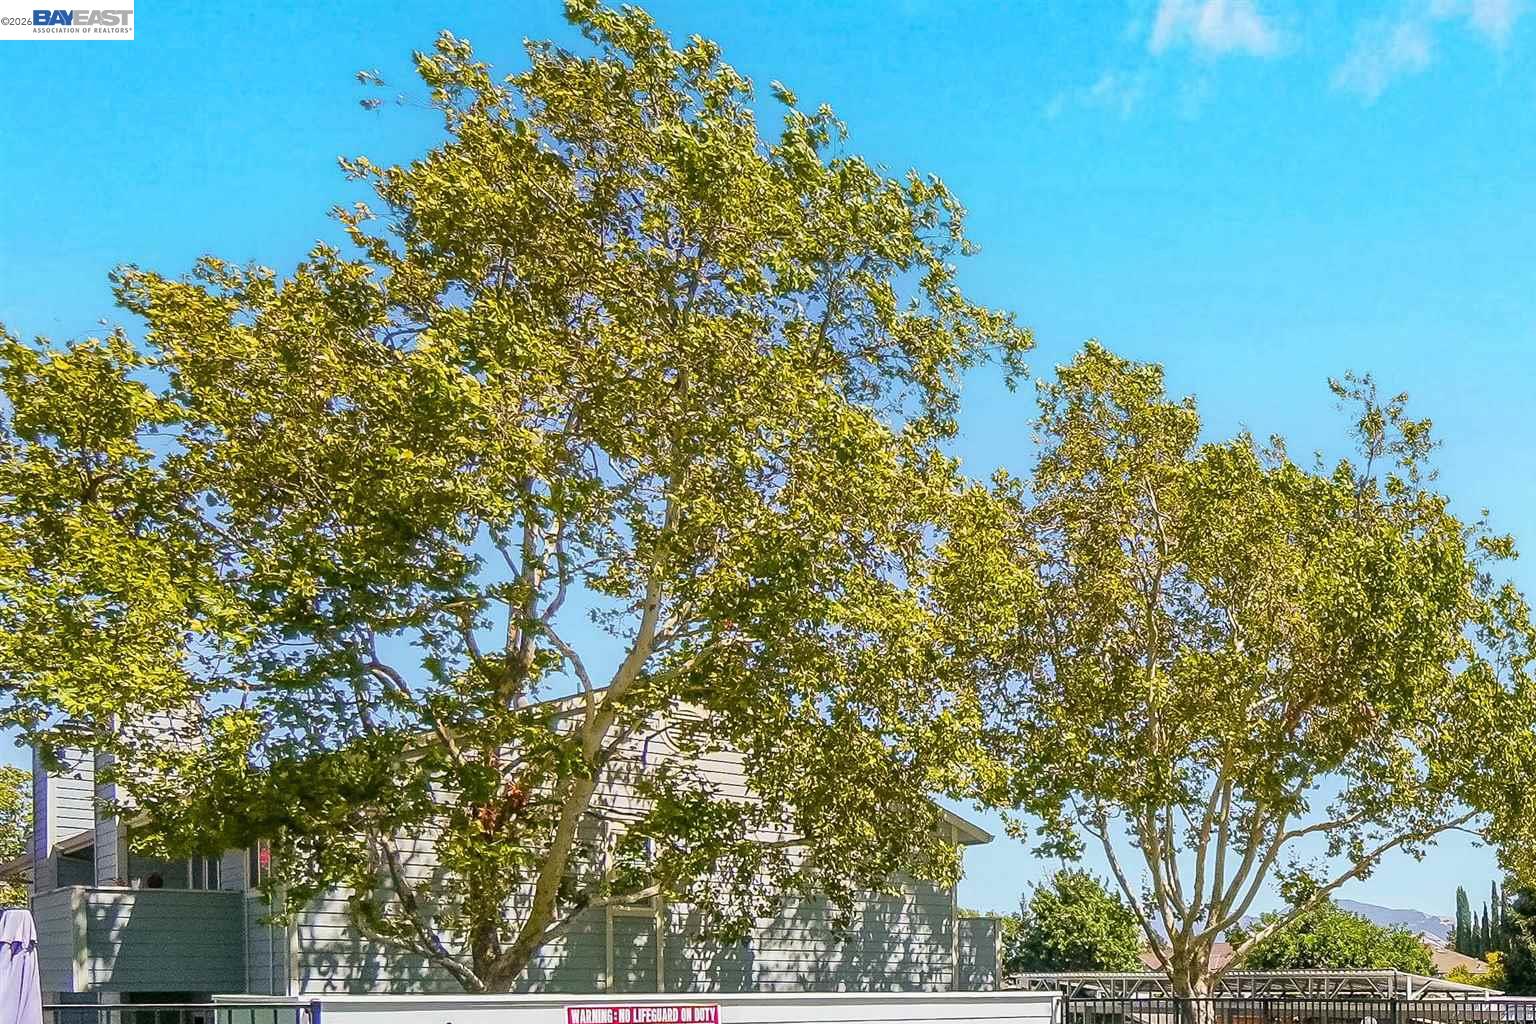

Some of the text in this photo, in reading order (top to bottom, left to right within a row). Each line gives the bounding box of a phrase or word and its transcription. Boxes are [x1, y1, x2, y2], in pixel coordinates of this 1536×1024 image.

[618, 1008, 631, 1024] NO
[633, 1007, 678, 1023] LIFEGUARD
[681, 1007, 692, 1022] ON
[695, 1006, 716, 1022] DUTY
